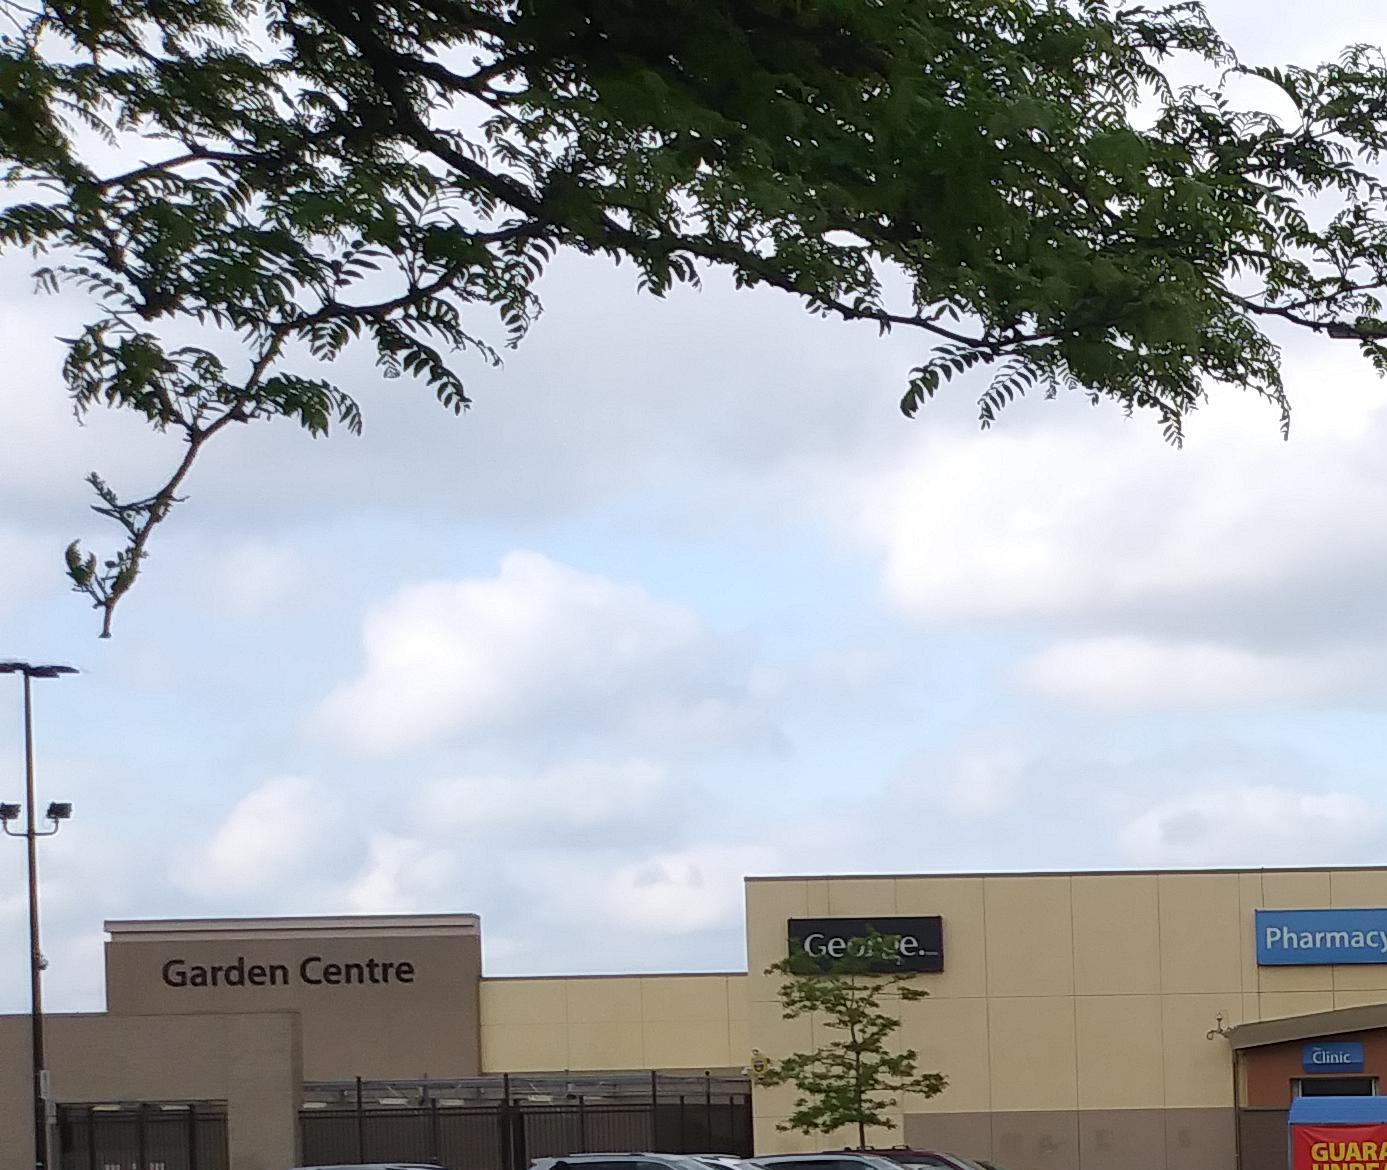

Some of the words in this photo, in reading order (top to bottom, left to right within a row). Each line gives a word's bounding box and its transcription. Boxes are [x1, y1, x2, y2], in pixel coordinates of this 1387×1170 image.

[803, 933, 925, 966] Gee.
[161, 956, 290, 988] Garden
[300, 956, 416, 986] Centre
[1312, 1050, 1352, 1064] Clinic
